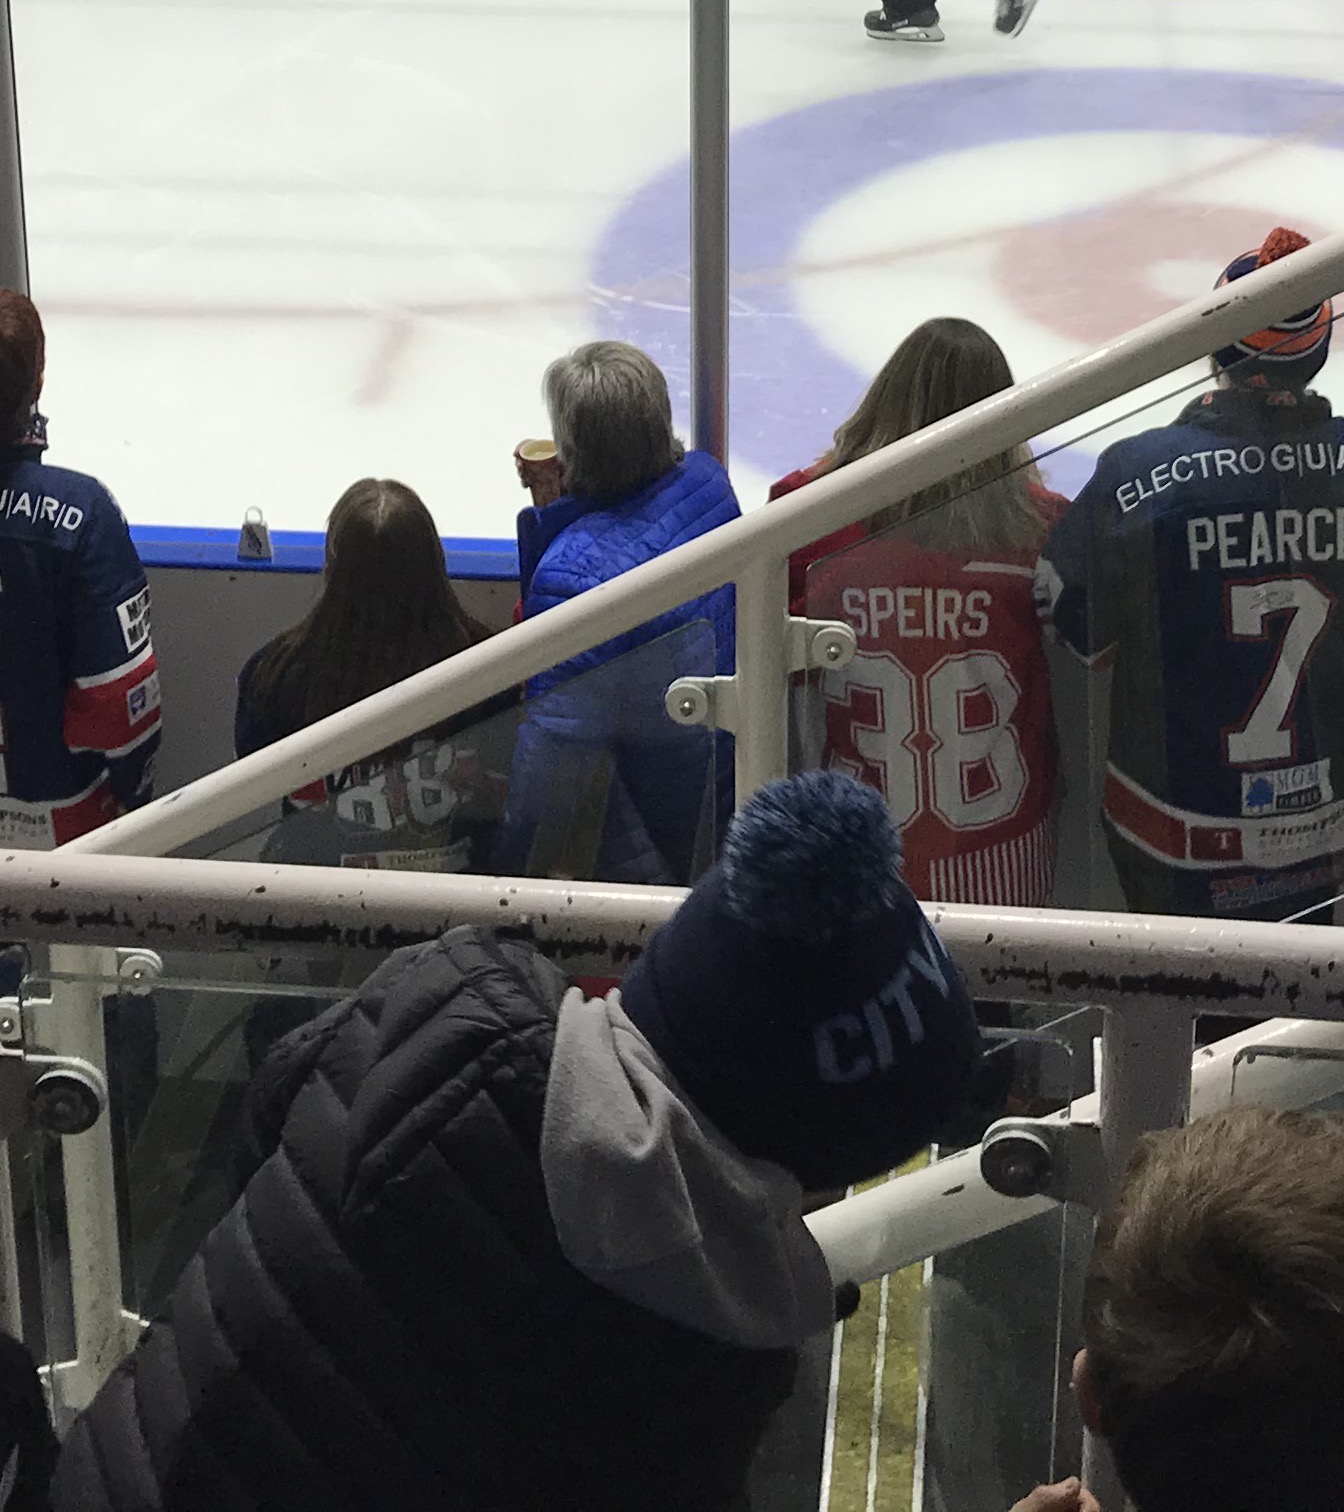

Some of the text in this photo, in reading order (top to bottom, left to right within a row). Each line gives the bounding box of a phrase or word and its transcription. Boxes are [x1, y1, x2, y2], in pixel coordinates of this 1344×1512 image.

[842, 587, 992, 640] SPEIRS
[1224, 573, 1340, 767] 7
[813, 918, 951, 1084] CITY
